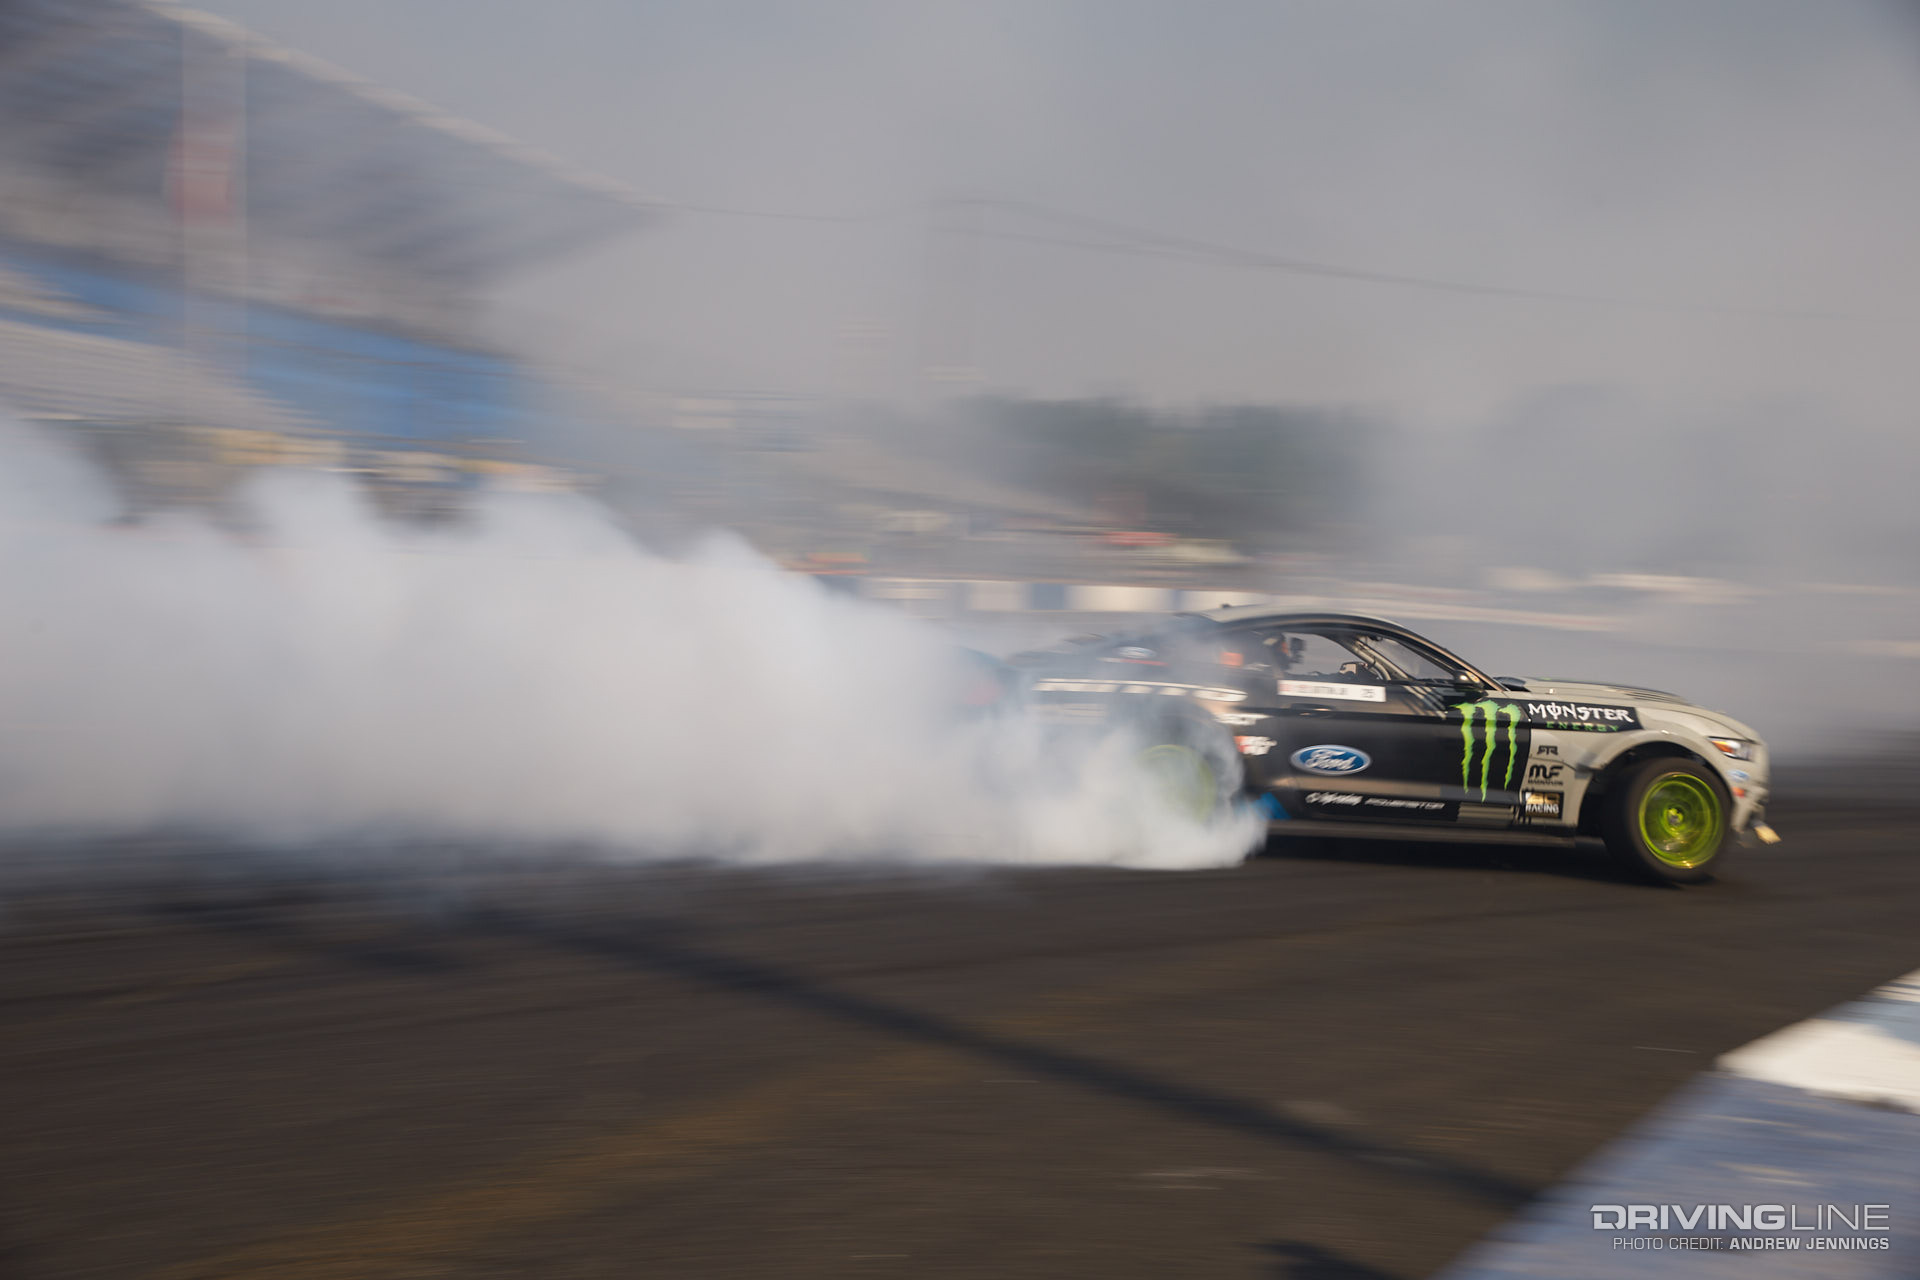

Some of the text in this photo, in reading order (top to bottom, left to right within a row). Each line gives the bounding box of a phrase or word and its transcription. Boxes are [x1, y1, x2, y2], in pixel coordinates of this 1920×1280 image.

[1528, 702, 1635, 723] MONSTER
[1546, 721, 1619, 732] ENERGY
[1304, 750, 1358, 771] Ford
[1525, 803, 1559, 814] RACING
